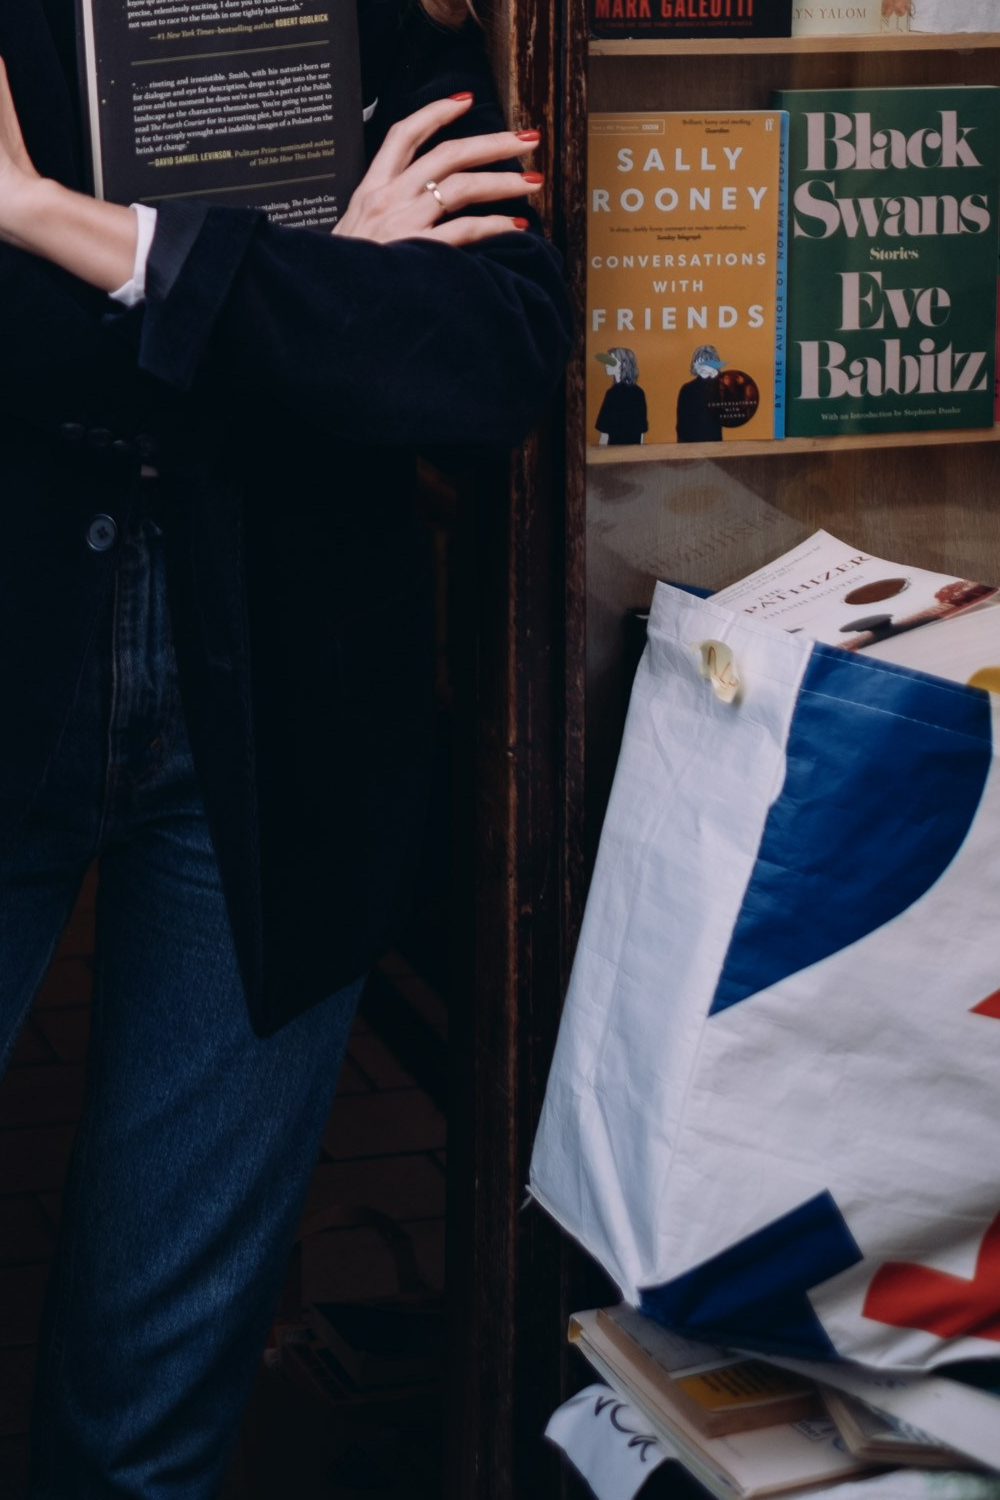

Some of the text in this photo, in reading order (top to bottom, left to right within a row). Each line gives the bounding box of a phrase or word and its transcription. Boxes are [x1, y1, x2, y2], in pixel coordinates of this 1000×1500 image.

[126, 0, 146, 8] know
[818, 7, 867, 20] YALOM
[705, 127, 730, 135] Guardian
[799, 109, 984, 172] Black
[616, 146, 743, 173] SALLY
[591, 186, 768, 212] ROONEY
[792, 179, 991, 239] Swans
[591, 252, 766, 269] CONVERSATIONS
[869, 246, 919, 261] Stories
[652, 279, 704, 294] WITH
[774, 141, 786, 409] BY THE AUTHOR OF NORMAL PEOPLE
[835, 271, 952, 332] Eve
[591, 304, 765, 332] FRIENDS
[793, 336, 989, 400] Babitz
[821, 411, 838, 421] With
[850, 409, 893, 420] Introduction
[894, 409, 902, 419] by
[903, 407, 937, 418] Stephanie
